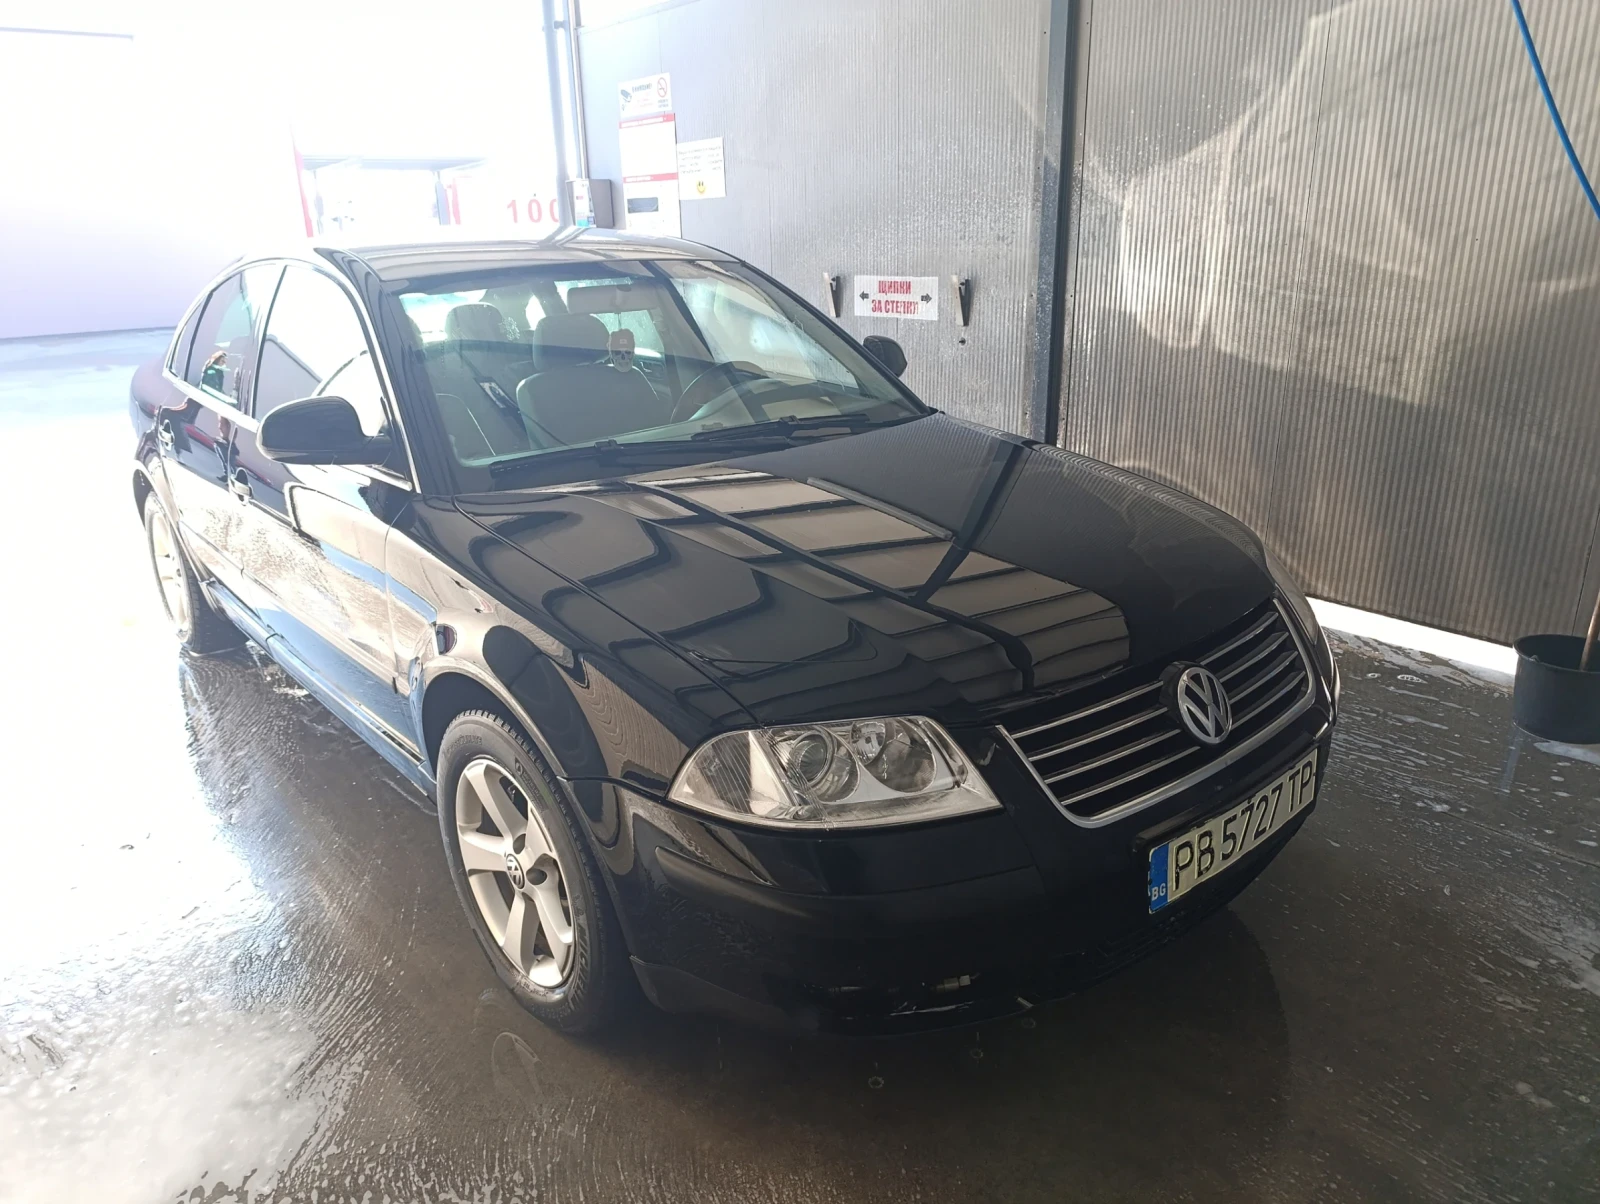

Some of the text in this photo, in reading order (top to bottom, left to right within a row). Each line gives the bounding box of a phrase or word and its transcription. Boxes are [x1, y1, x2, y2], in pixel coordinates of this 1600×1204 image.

[878, 280, 912, 295] ЩИПКИ
[871, 299, 882, 313] ЗА
[1172, 760, 1314, 892] PB 5727 TP
[1151, 883, 1167, 902] BG
